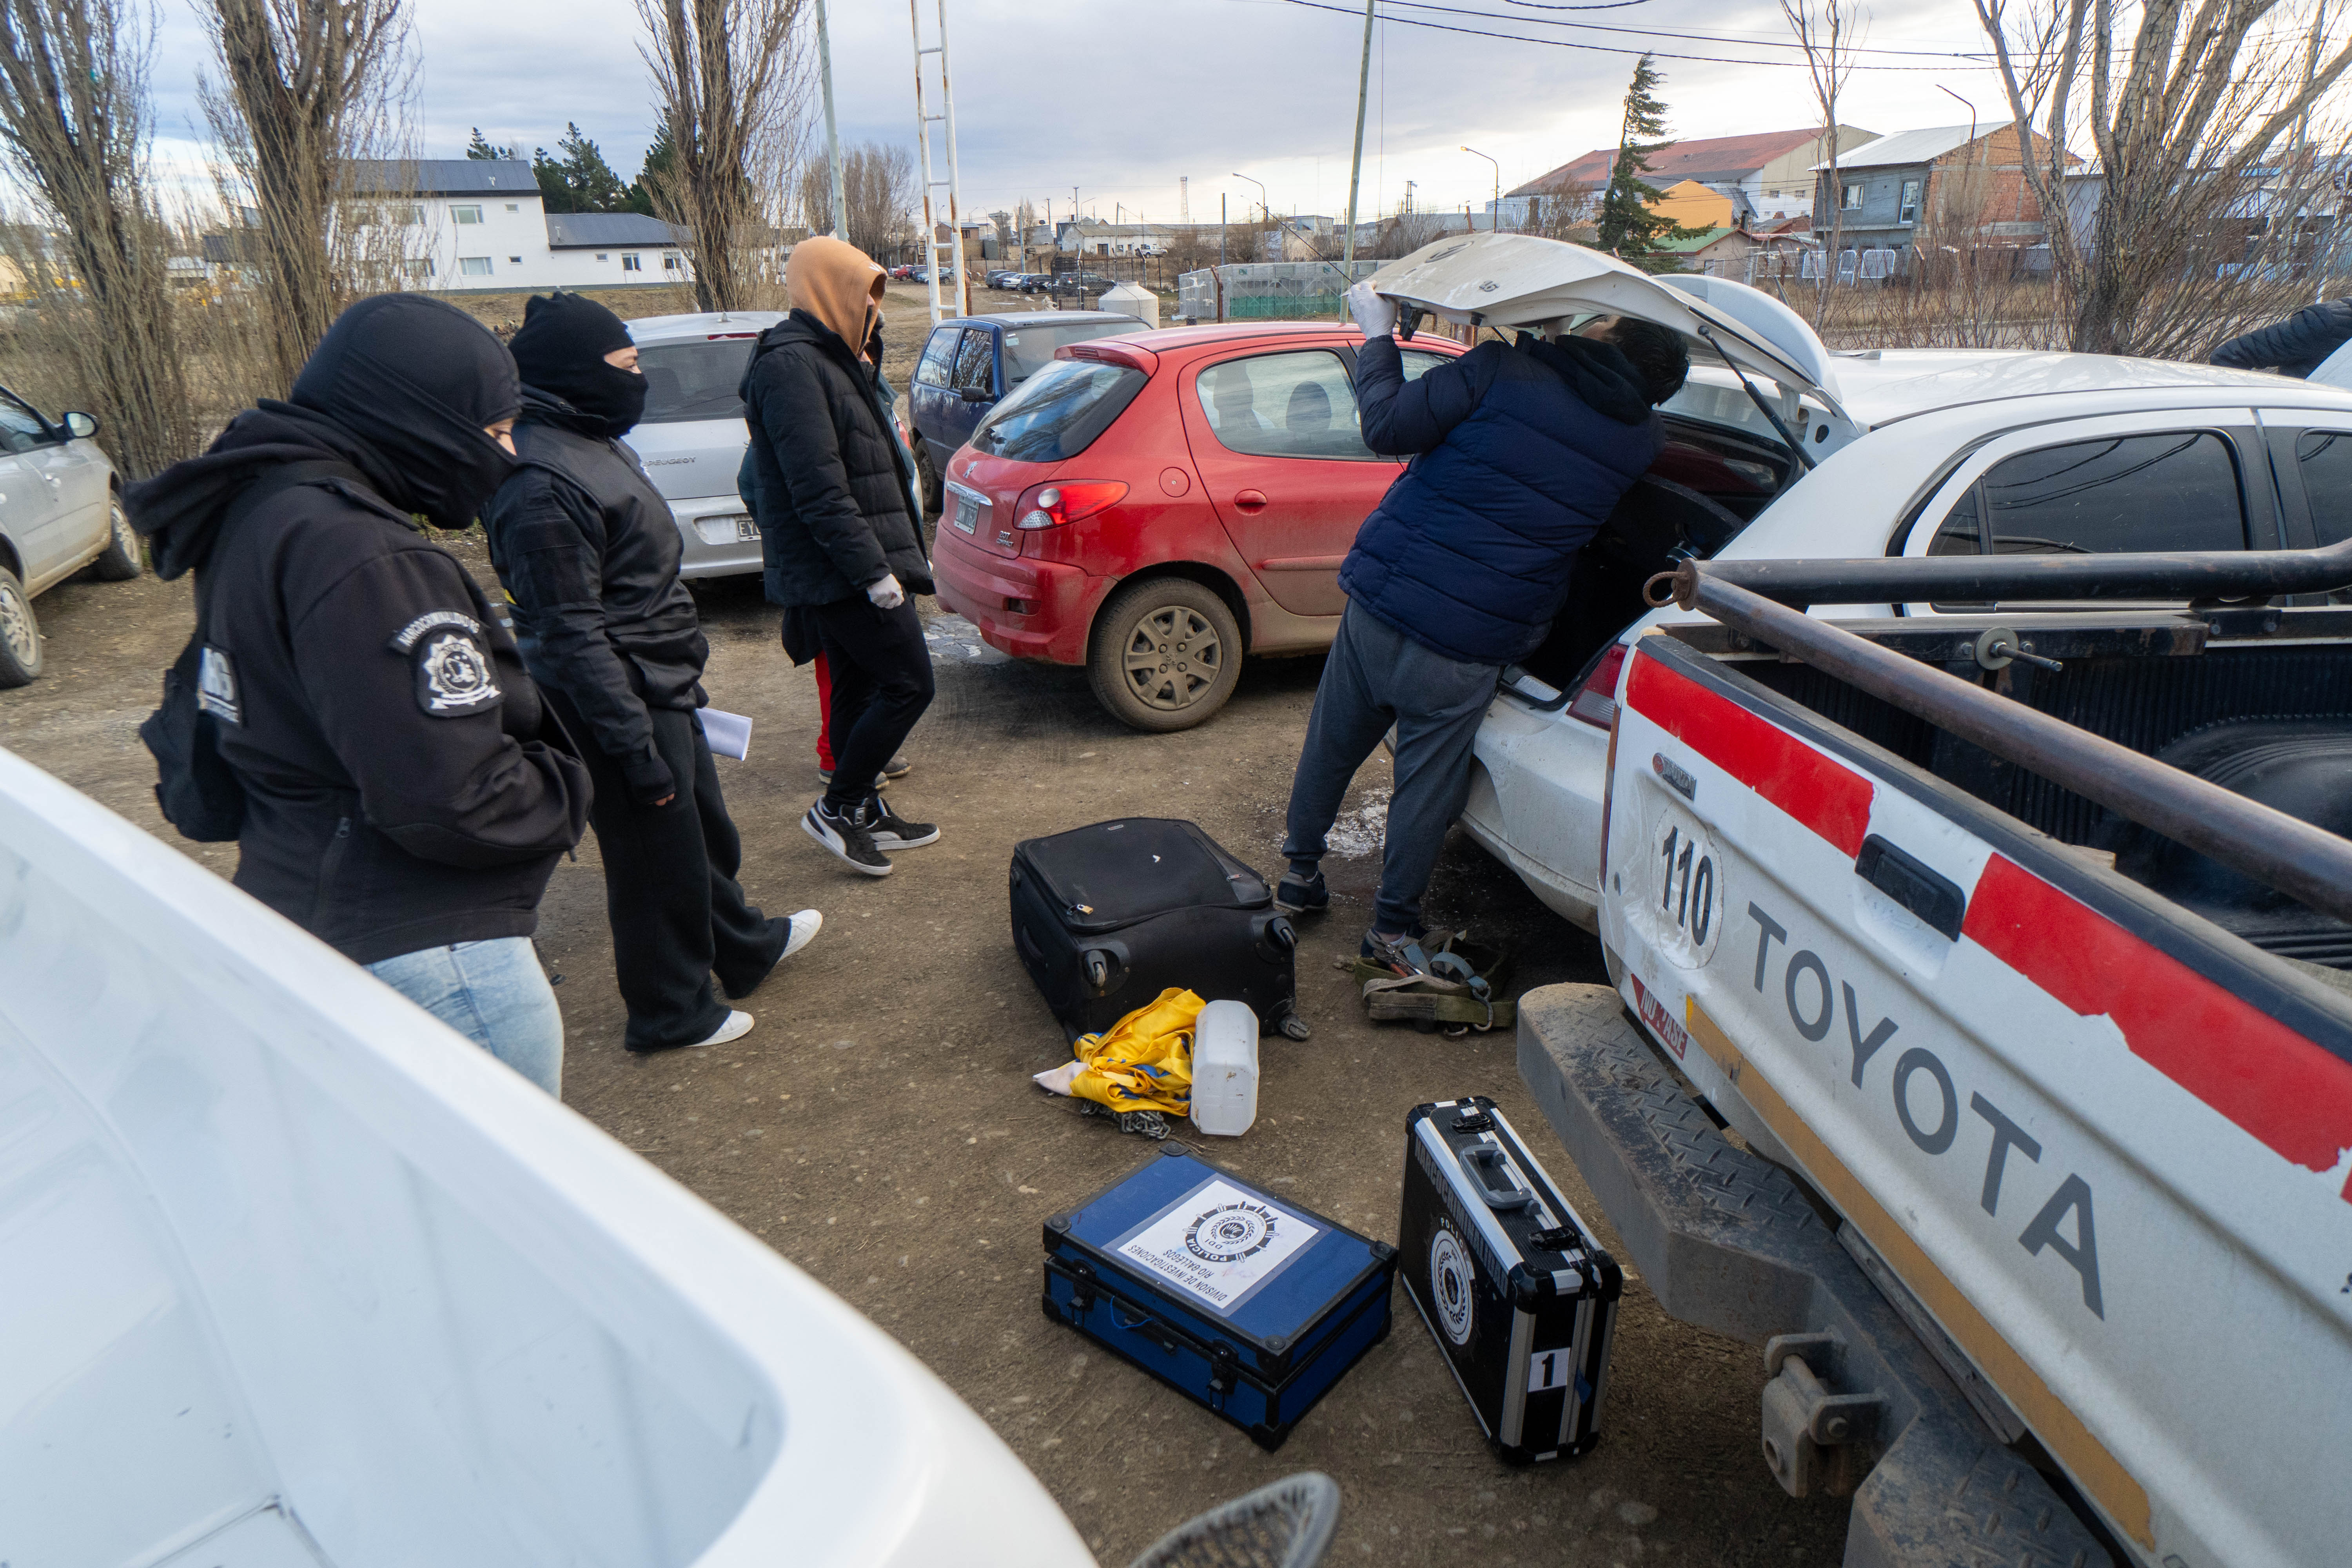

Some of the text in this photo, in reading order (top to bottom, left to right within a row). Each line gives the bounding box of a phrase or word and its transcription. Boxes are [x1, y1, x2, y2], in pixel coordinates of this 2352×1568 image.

[647, 457, 696, 466] PEUGEOT
[999, 530, 1011, 540] 207
[1662, 825, 1713, 946] 110
[1748, 900, 2104, 1321] TOYOTA
[1414, 1135, 1508, 1299] NARCOCRIMINALIDAD
[1187, 1238, 1227, 1261] POLICIA
[1205, 1239, 1223, 1250] DDI
[1128, 1245, 1227, 1301] DIVISIÓN DE INVESTIGACIONES
[1163, 1249, 1201, 1271] GALLEGOS
[1542, 1353, 1555, 1387] 1
